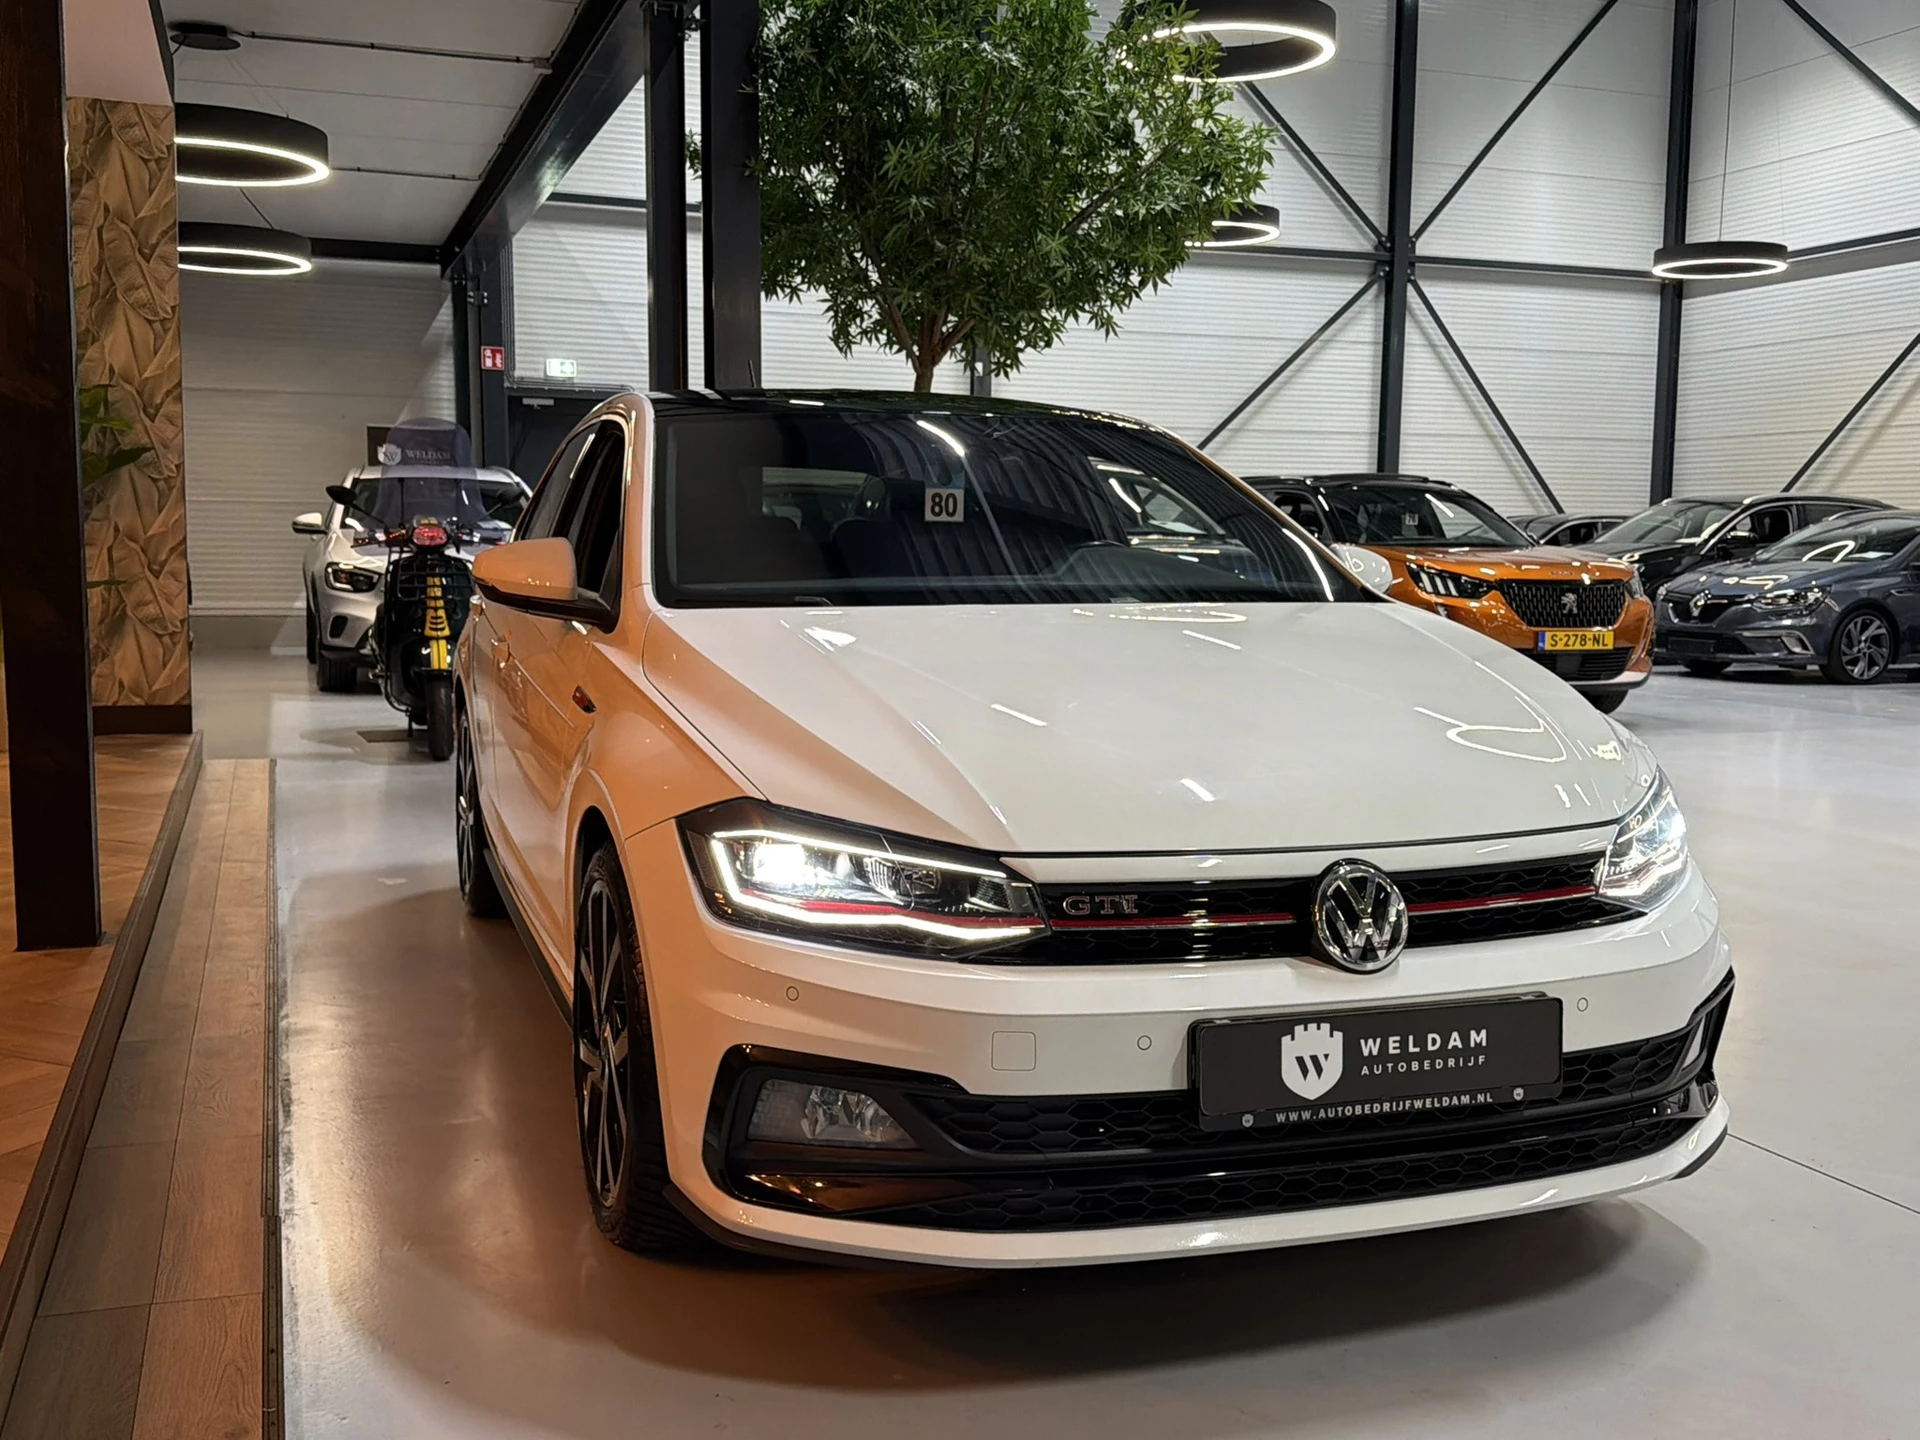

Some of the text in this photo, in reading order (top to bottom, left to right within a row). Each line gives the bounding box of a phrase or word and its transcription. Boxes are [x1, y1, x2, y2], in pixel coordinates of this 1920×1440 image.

[930, 492, 958, 518] 80
[1550, 633, 1609, 647] S-278-NL
[1062, 894, 1139, 916] GTI
[1360, 1028, 1488, 1057] WELDAM
[1360, 1055, 1487, 1076] AUTOBEDRIJF
[1275, 1092, 1494, 1124] WWW.AUTOBEDRIJFWELDAM.NL
